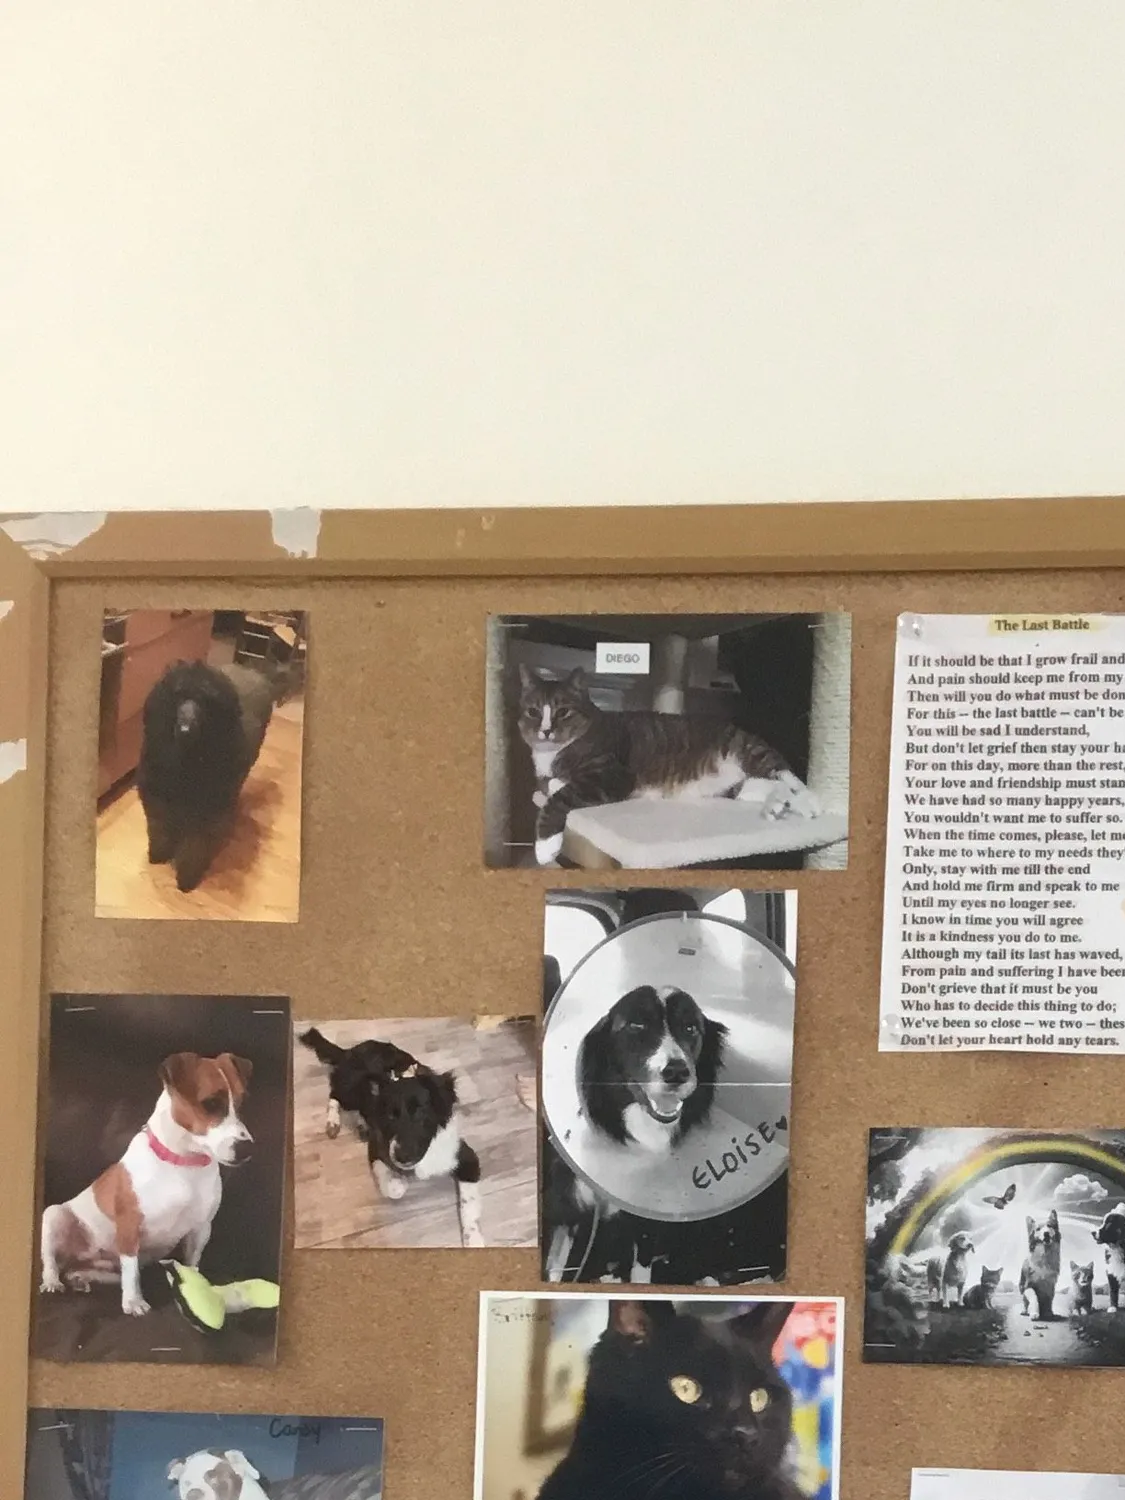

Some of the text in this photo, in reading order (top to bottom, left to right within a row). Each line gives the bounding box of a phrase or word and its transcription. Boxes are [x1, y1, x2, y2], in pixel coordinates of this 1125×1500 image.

[994, 618, 1090, 632] The Last Battle
[606, 653, 640, 663] DIEGO
[908, 655, 919, 667] If
[922, 656, 932, 667] it
[934, 655, 977, 667] should
[979, 655, 995, 667] be
[997, 654, 1023, 666] that
[1026, 654, 1032, 666] I
[1035, 656, 1068, 669] grow
[1071, 653, 1098, 665] frail
[1101, 653, 1125, 665] and
[907, 673, 935, 685] And
[938, 673, 966, 688] pain
[968, 672, 1011, 684] should
[1013, 672, 1044, 686] keep
[1046, 674, 1066, 683] me
[1068, 671, 1101, 683] from
[1104, 674, 1124, 686] my
[909, 690, 940, 703] Then
[943, 691, 967, 702] will
[970, 693, 993, 705] you
[995, 690, 1012, 702] do
[1014, 690, 1046, 701] what
[1048, 690, 1081, 700] must
[1084, 689, 1100, 701] be
[908, 724, 1091, 738] You will be sad I understand,
[905, 742, 929, 754] But
[931, 742, 965, 754] don't
[968, 742, 984, 754] let
[987, 742, 1017, 757] grief
[1020, 742, 1048, 754] then
[1051, 744, 1077, 756] stay
[1080, 745, 1111, 756] your
[905, 760, 929, 771] For
[931, 762, 948, 772] on
[950, 760, 974, 771] this
[976, 760, 1005, 774] day,
[1007, 763, 1041, 771] more
[1043, 760, 1073, 771] than
[1076, 759, 1097, 771] the
[906, 777, 938, 788] Your
[941, 777, 967, 788] love
[969, 777, 994, 789] and
[997, 777, 1062, 792] friendship
[1065, 778, 1097, 789] must
[903, 896, 1076, 912] Until my eyes no longer see.
[900, 1034, 1120, 1049] Don't let your heart hold any tears.
